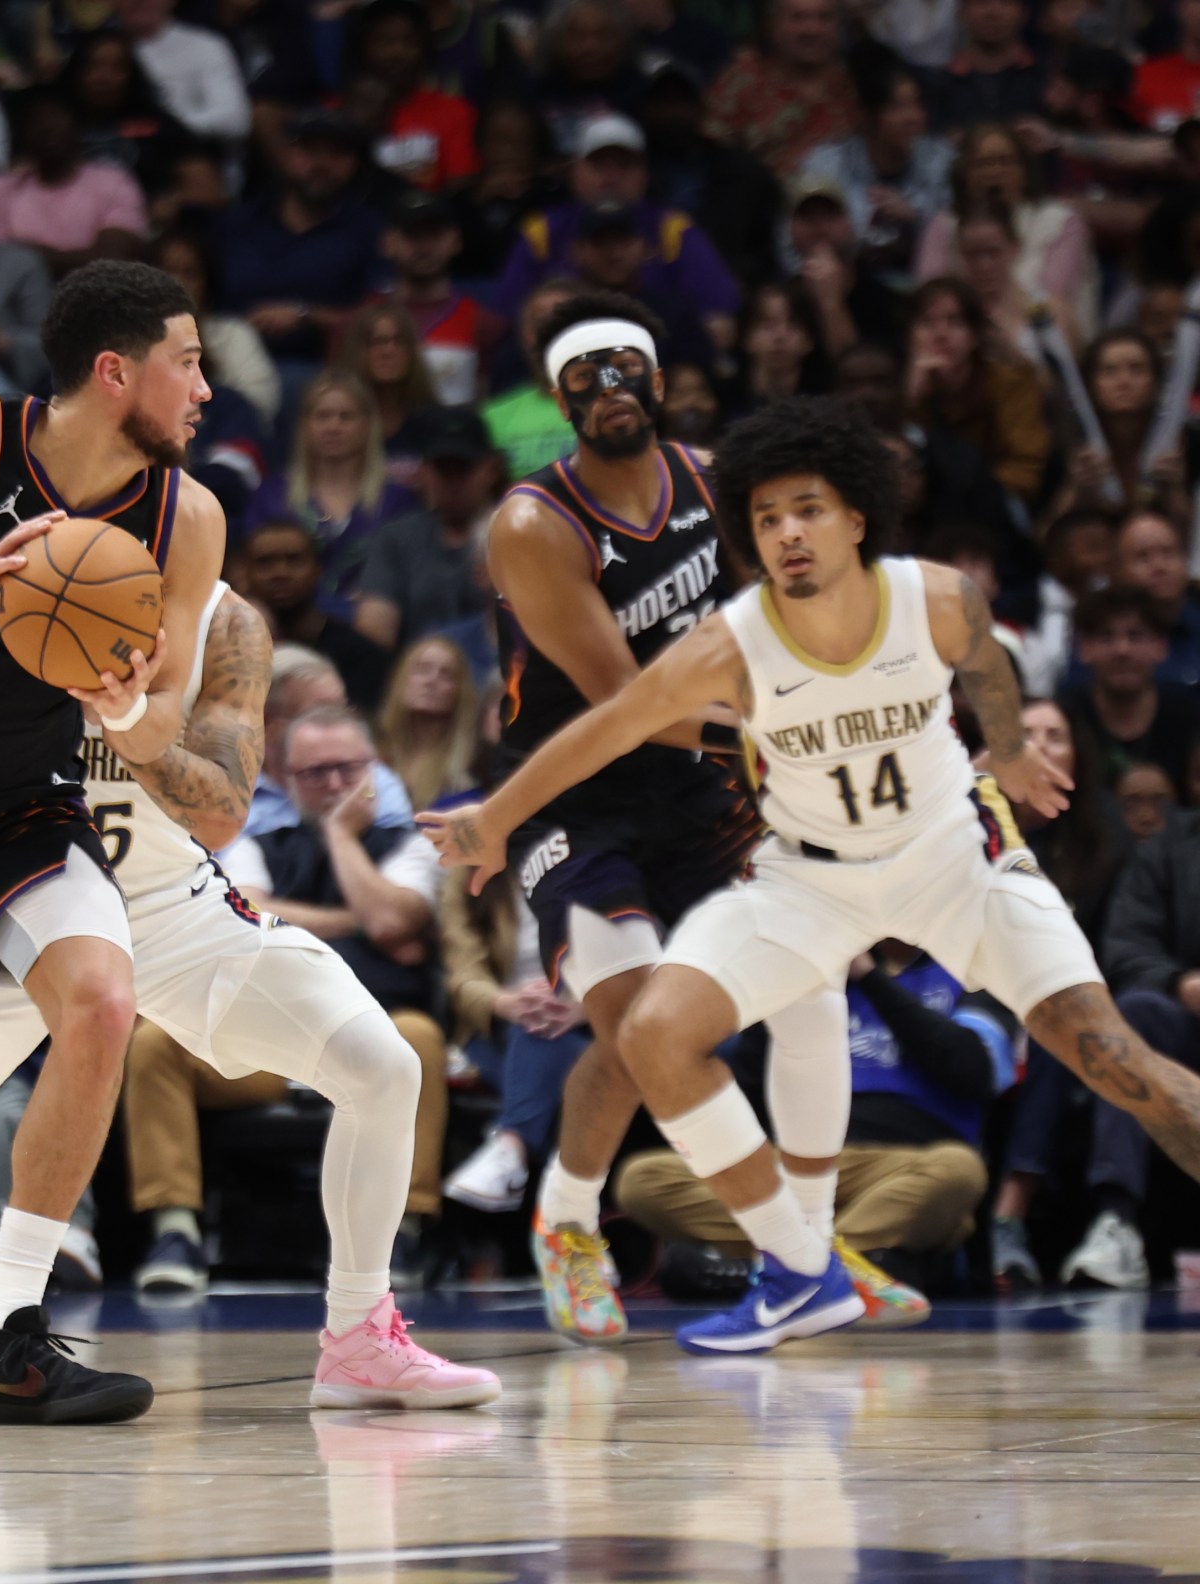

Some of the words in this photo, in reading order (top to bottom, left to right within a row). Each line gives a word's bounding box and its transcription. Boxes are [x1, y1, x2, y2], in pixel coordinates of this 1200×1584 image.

[671, 508, 710, 533] PayPal
[615, 538, 720, 638] HOENIX
[765, 720, 824, 759] NEW
[833, 694, 943, 749] ORLEAN
[826, 750, 911, 826] 14
